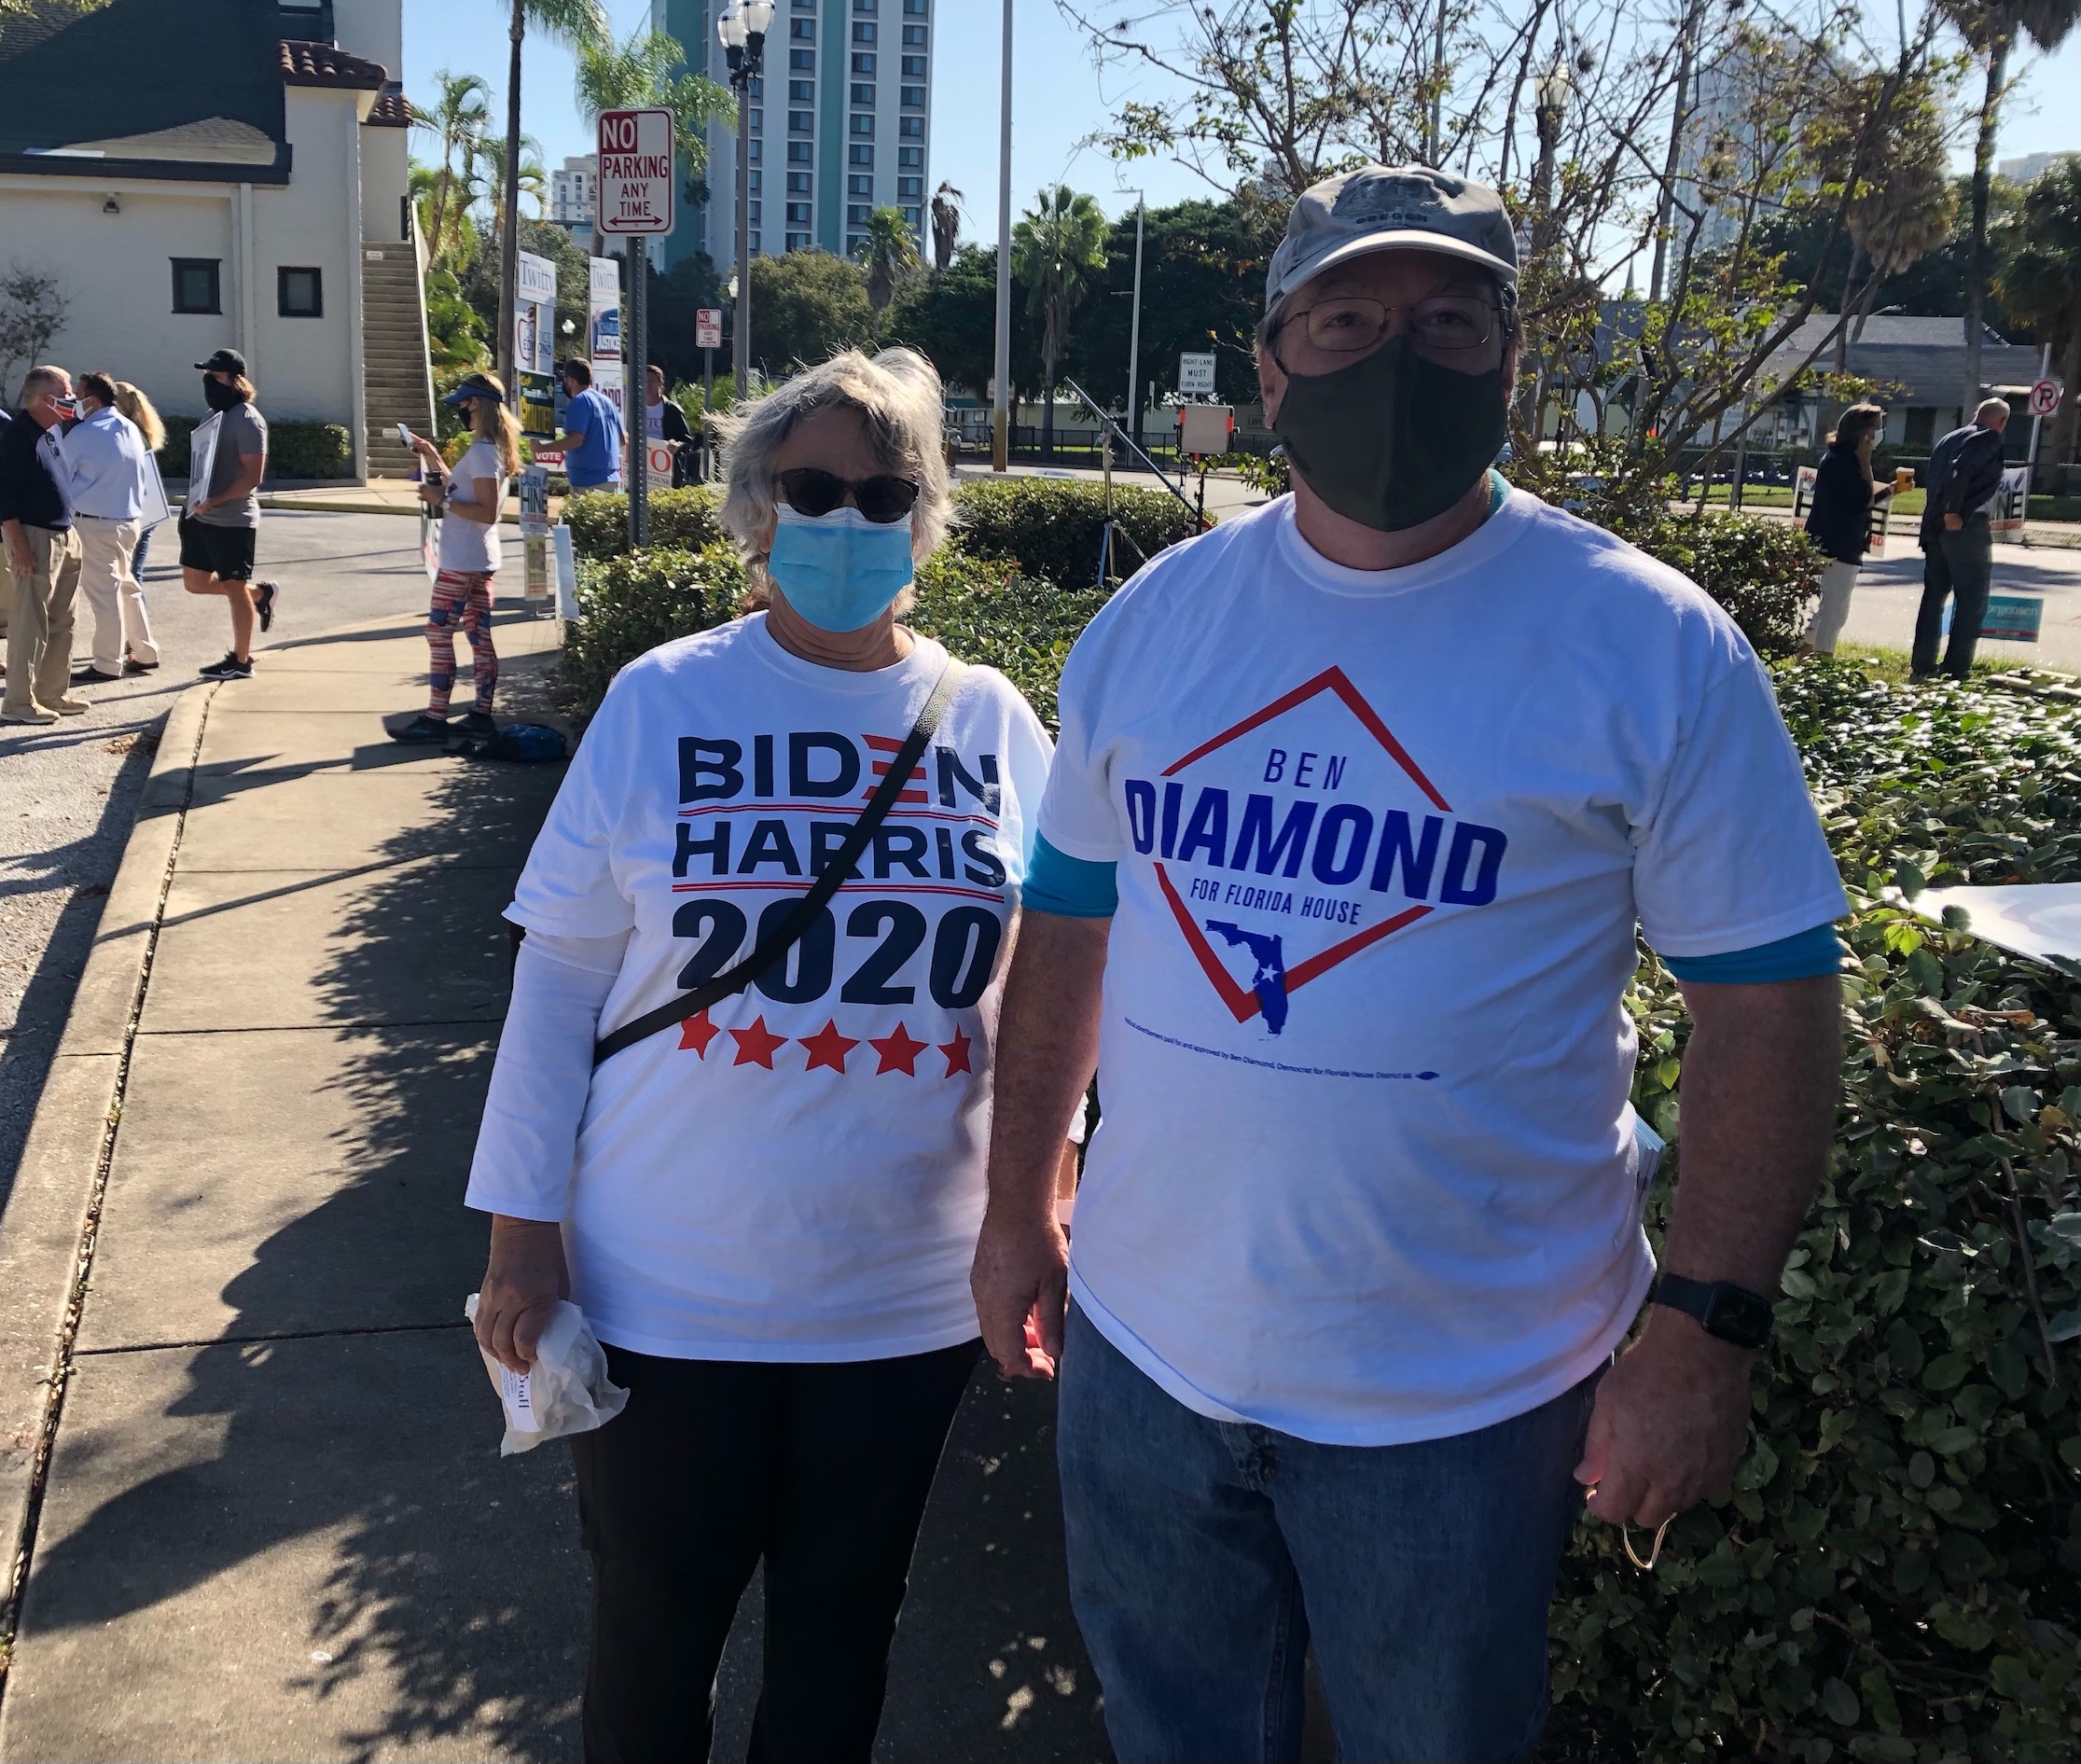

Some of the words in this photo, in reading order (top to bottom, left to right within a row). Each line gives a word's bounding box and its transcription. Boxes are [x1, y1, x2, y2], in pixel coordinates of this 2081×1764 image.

[602, 118, 634, 149] NO
[603, 155, 669, 179] PARKING
[621, 182, 649, 198] ANY
[619, 201, 651, 216] TIME
[520, 260, 554, 292] Twitty
[699, 312, 709, 322] NO
[596, 335, 621, 351] JUSTICE
[1187, 368, 1207, 378] MUST
[535, 452, 562, 461] VOTE
[520, 474, 541, 488] LAURA
[520, 486, 548, 514] HINE
[677, 731, 1001, 817] BIDEN
[1263, 748, 1348, 790] BEN
[673, 819, 1007, 887] HARRIS
[1124, 779, 1509, 907] DIAMOND
[1189, 878, 1220, 902] FOR
[1224, 884, 1293, 915] FLORIDA
[1300, 896, 1363, 926] HOUSE
[672, 898, 1002, 1009] 2020
